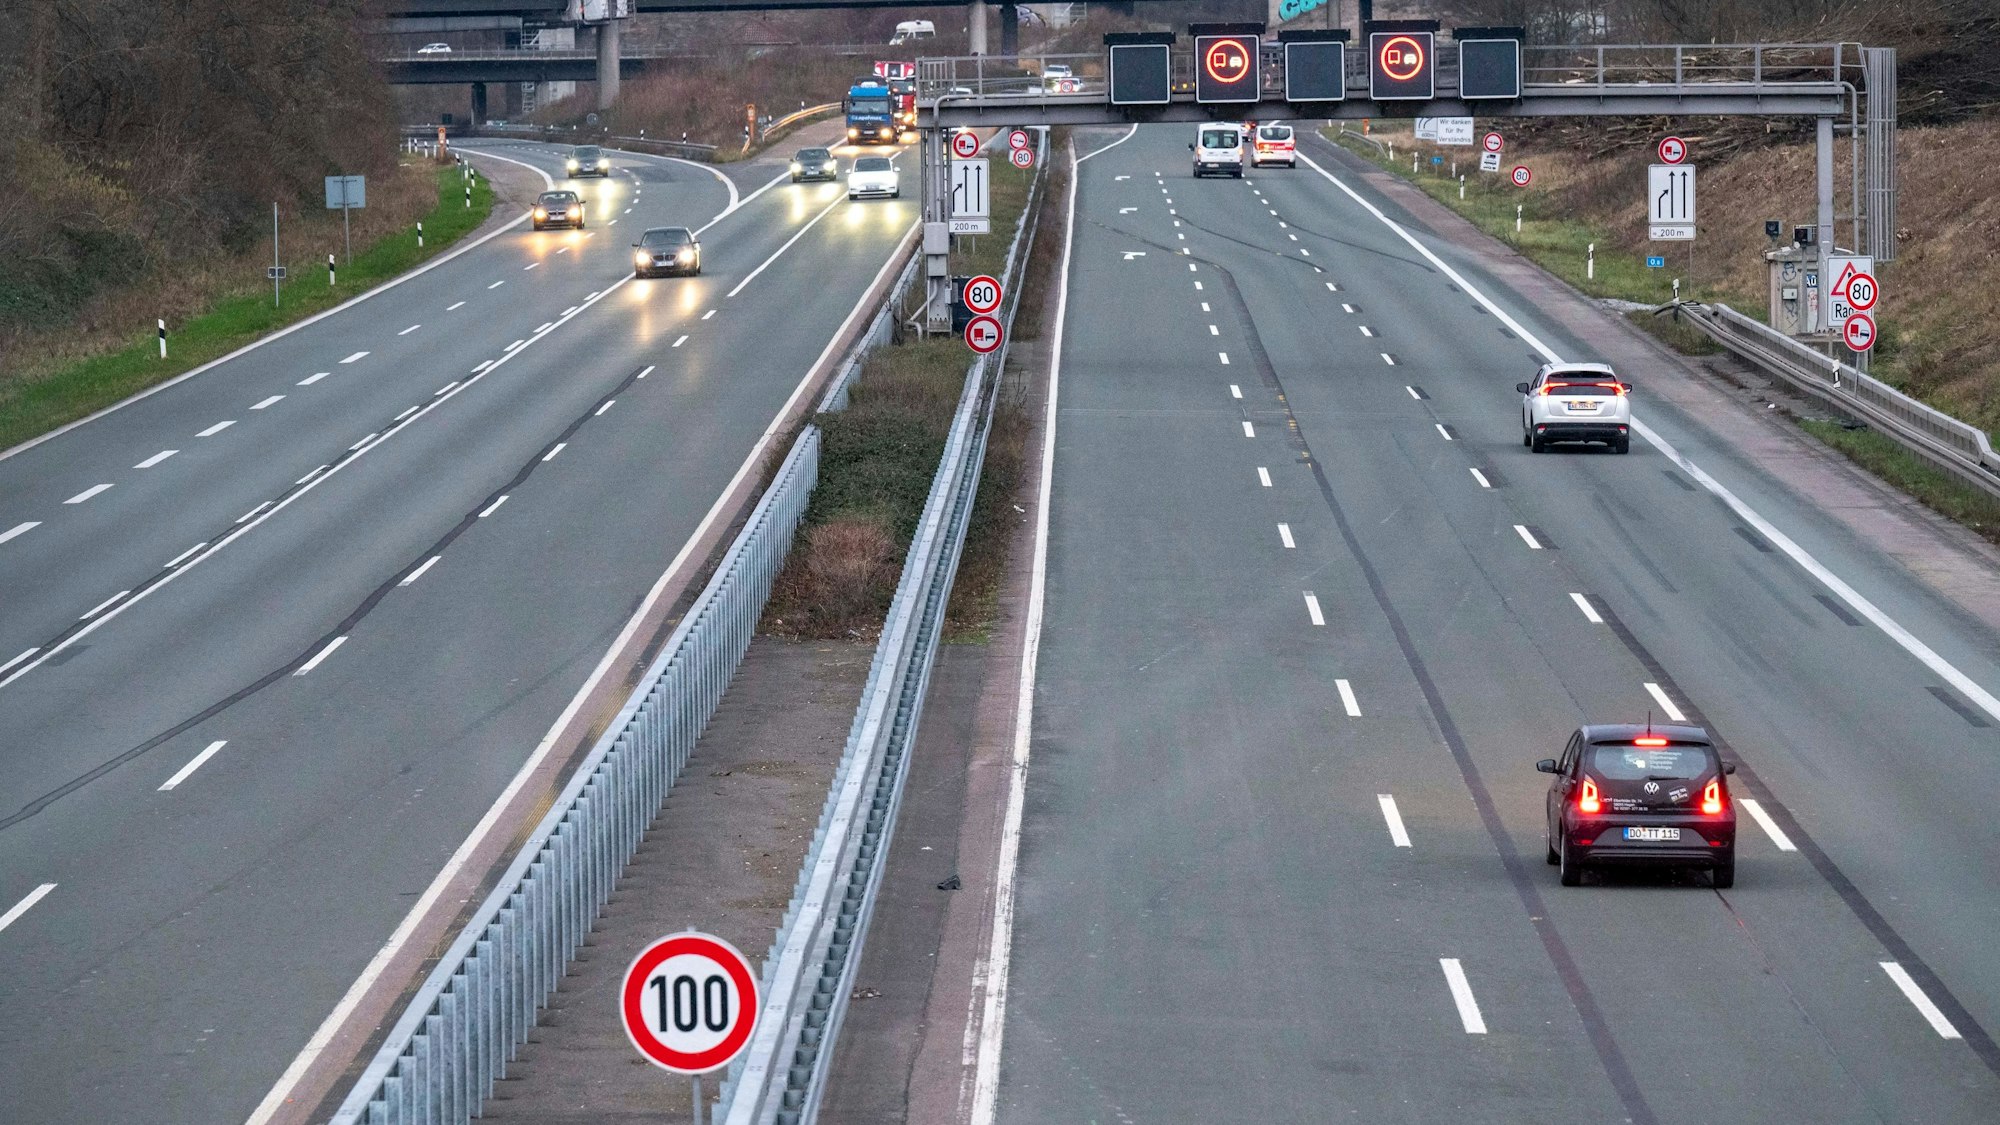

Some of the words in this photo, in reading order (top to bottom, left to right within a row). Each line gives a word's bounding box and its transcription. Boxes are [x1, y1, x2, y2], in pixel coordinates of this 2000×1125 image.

[1017, 152, 1030, 163] 80
[1515, 171, 1528, 181] 80
[954, 222, 970, 231] 200
[1660, 228, 1675, 237] 200
[972, 286, 993, 303] 80
[1851, 283, 1872, 301] 80
[1629, 828, 1642, 839] DO
[1648, 828, 1659, 839] TT
[1661, 828, 1679, 839] 115
[649, 974, 729, 1033] 100
